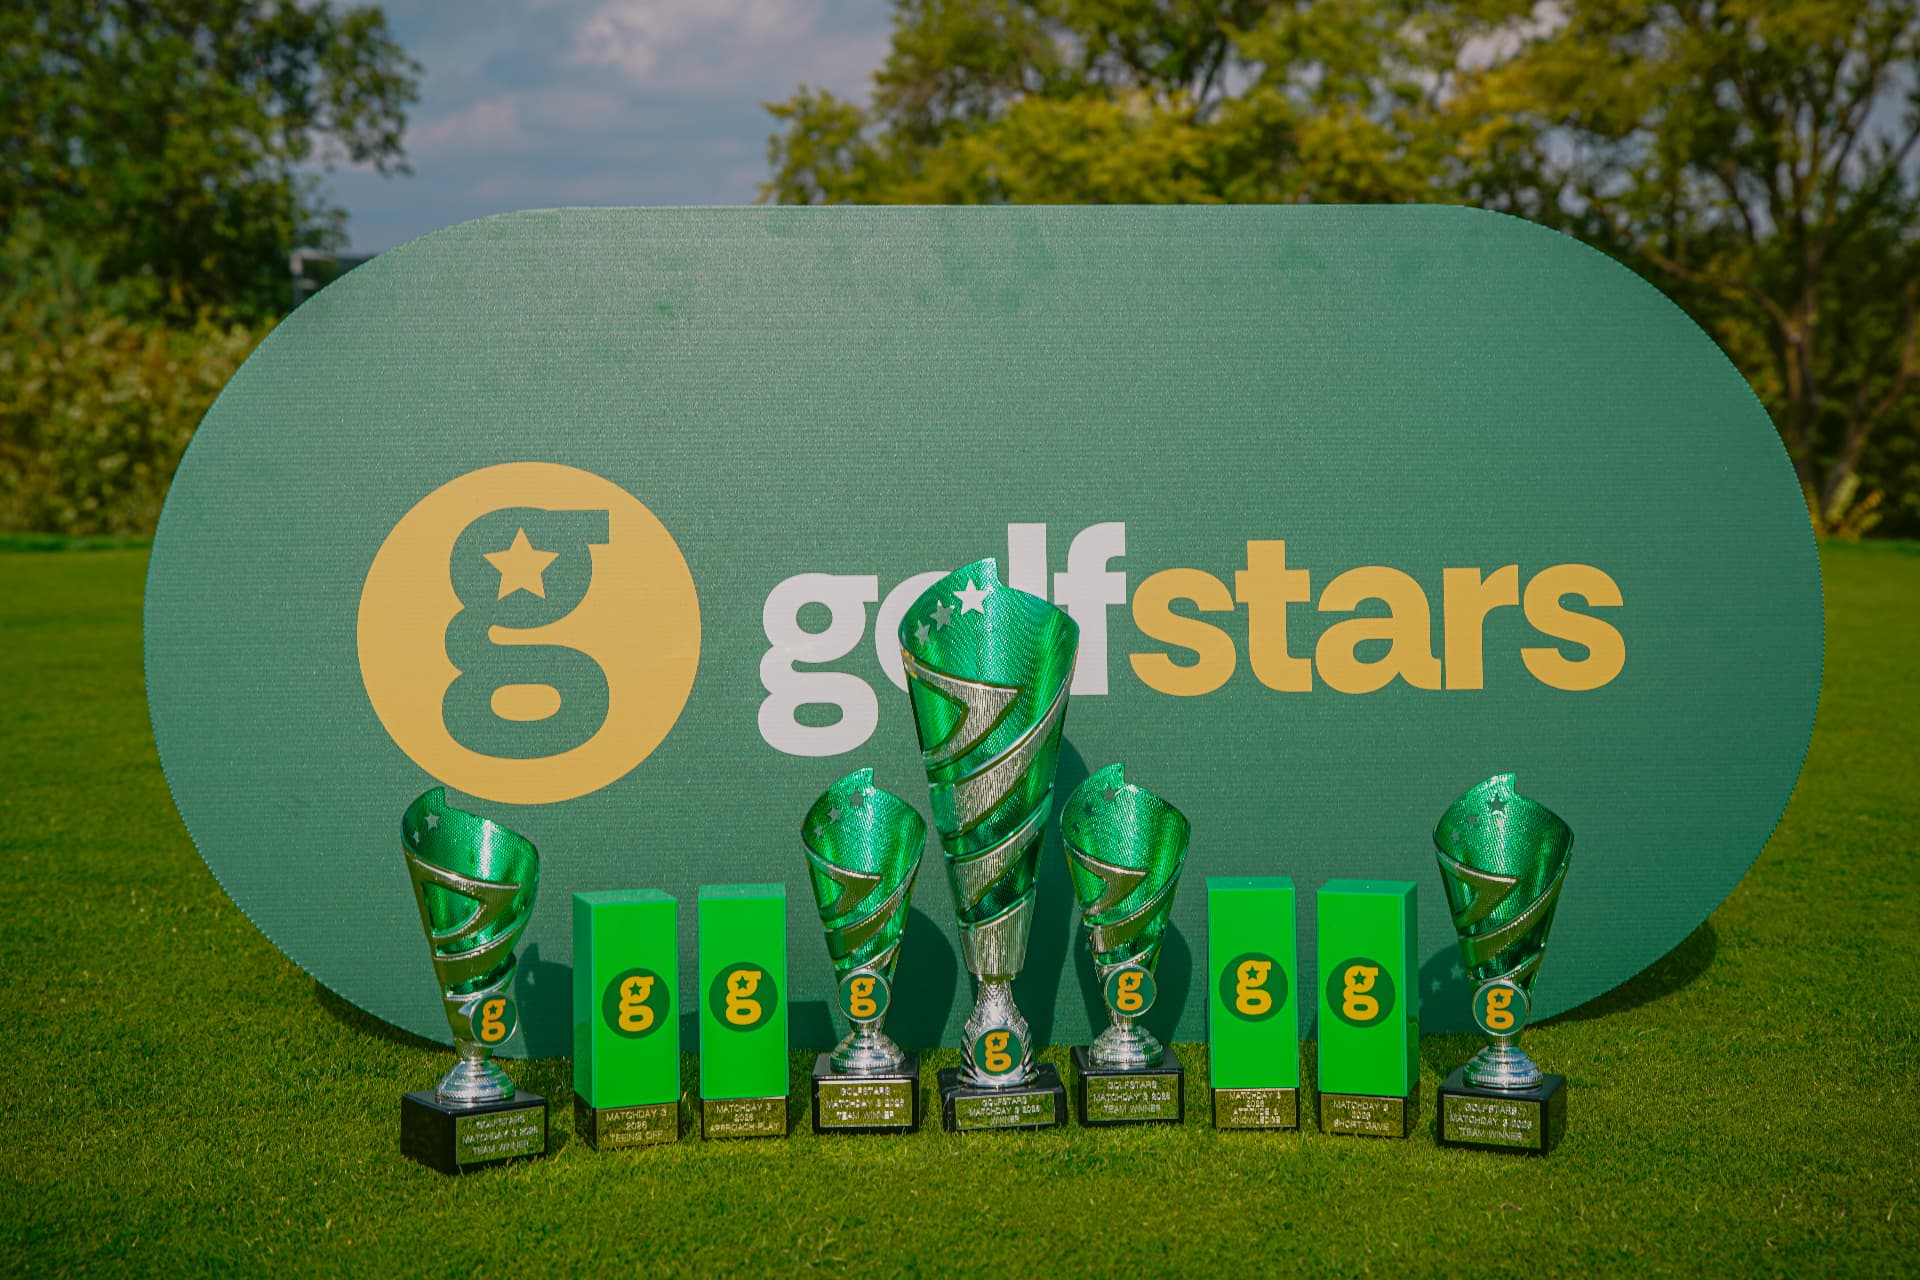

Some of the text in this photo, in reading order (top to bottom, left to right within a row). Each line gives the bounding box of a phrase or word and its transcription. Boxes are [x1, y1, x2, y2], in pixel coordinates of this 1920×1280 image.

[758, 522, 1626, 757] gfstars
[1093, 1092, 1140, 1102] MATCHDAY
[606, 1108, 667, 1121] MATCHDAY 3
[626, 1120, 647, 1131] 2026
[610, 1129, 663, 1142] TEEING OFF
